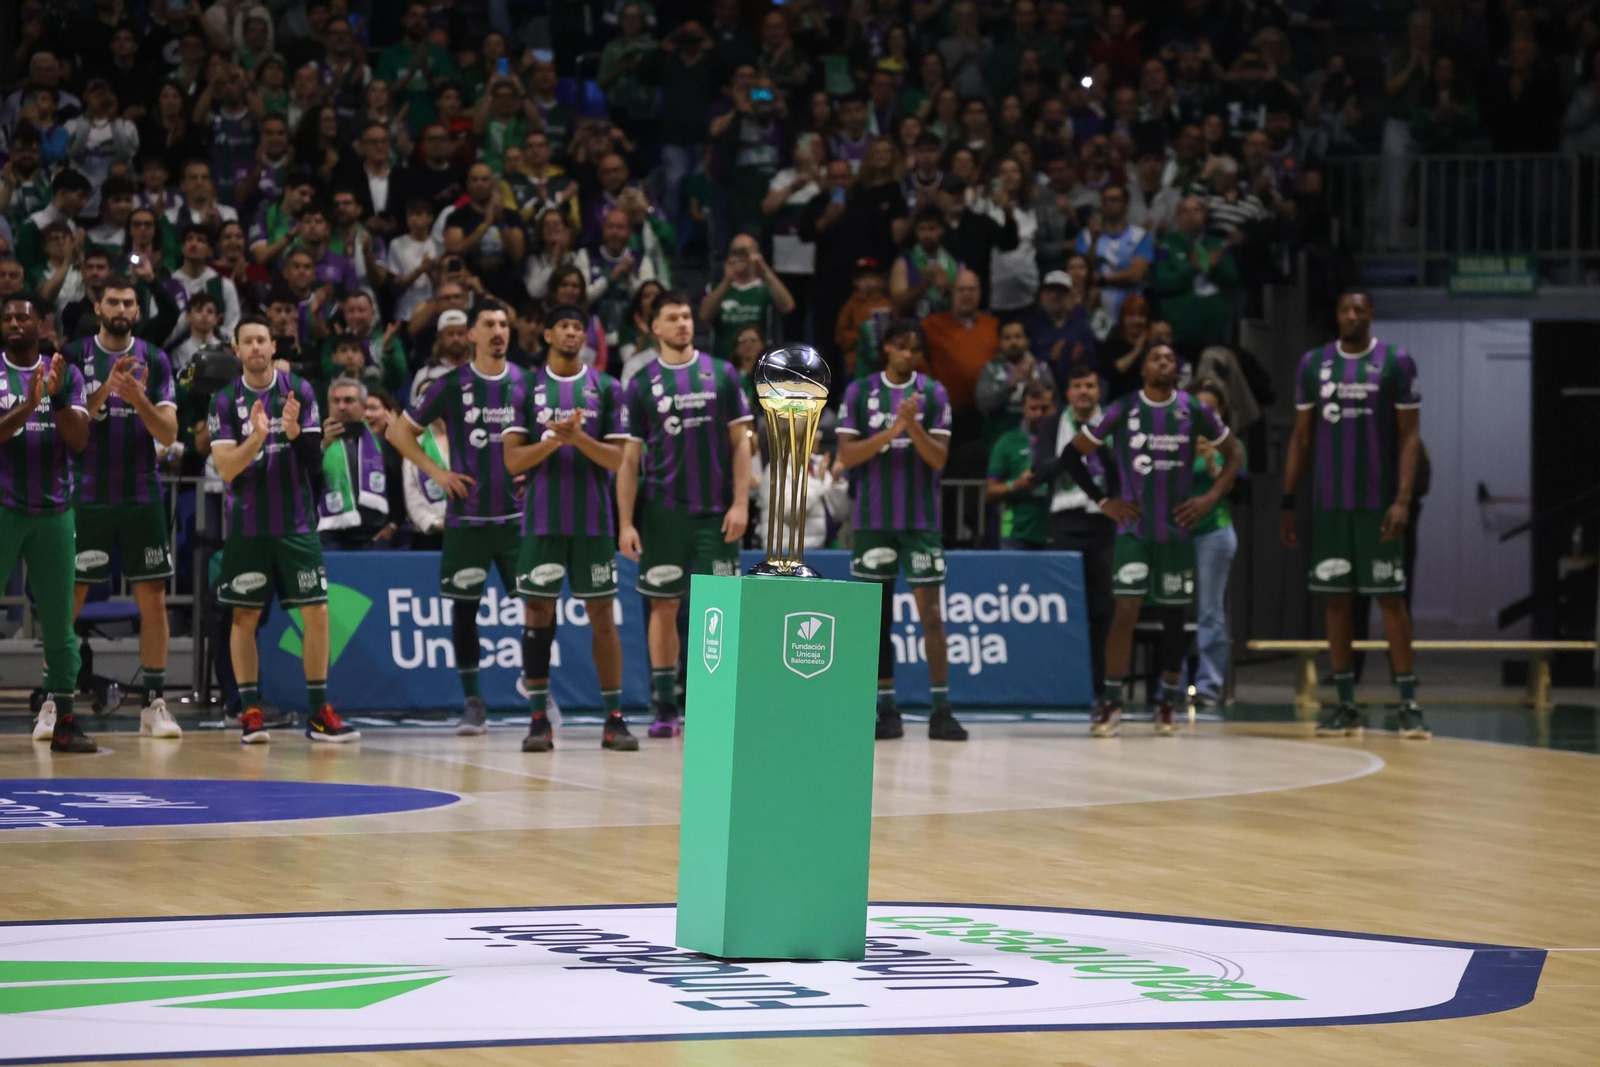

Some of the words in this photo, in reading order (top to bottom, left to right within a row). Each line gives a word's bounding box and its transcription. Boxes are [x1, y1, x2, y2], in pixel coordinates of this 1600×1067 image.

[791, 642, 826, 651] Fundación
[796, 650, 821, 660] Unicaja
[790, 657, 826, 665] Baloncesto
[869, 915, 1308, 1001] Baloncesto
